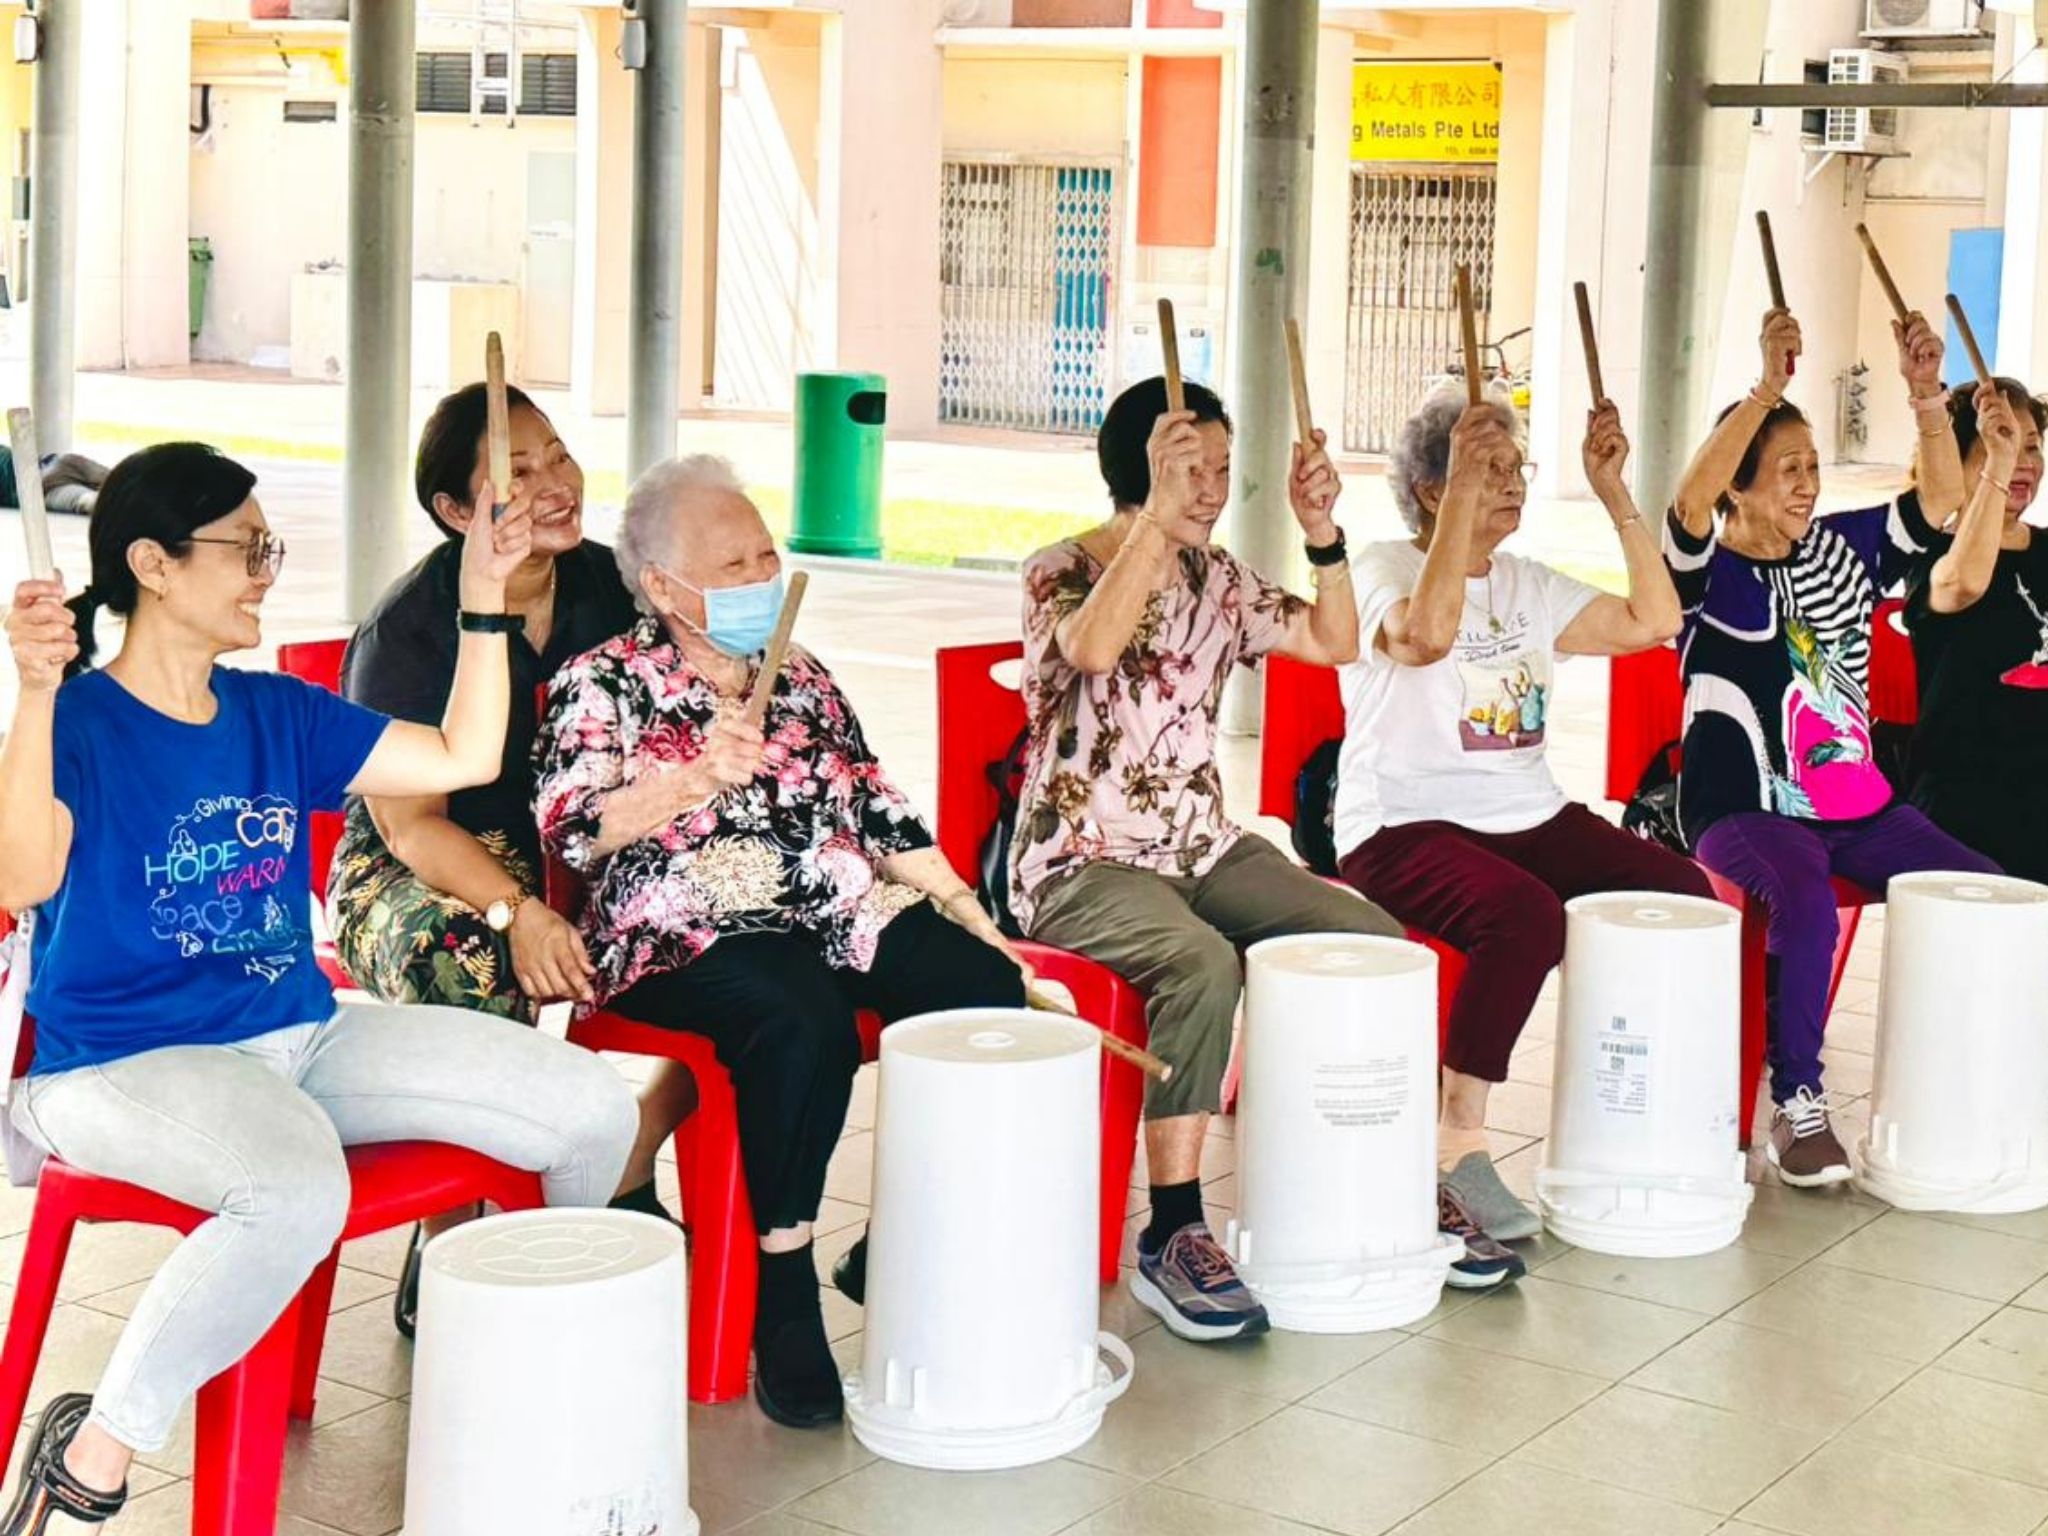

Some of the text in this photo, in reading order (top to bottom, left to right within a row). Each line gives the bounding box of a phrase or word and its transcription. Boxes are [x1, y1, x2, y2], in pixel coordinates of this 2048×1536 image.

[1352, 80, 1500, 109] 私人有限公司
[1371, 121, 1426, 138] Metals
[1435, 120, 1463, 138] Pte
[1472, 120, 1500, 138] Ltd
